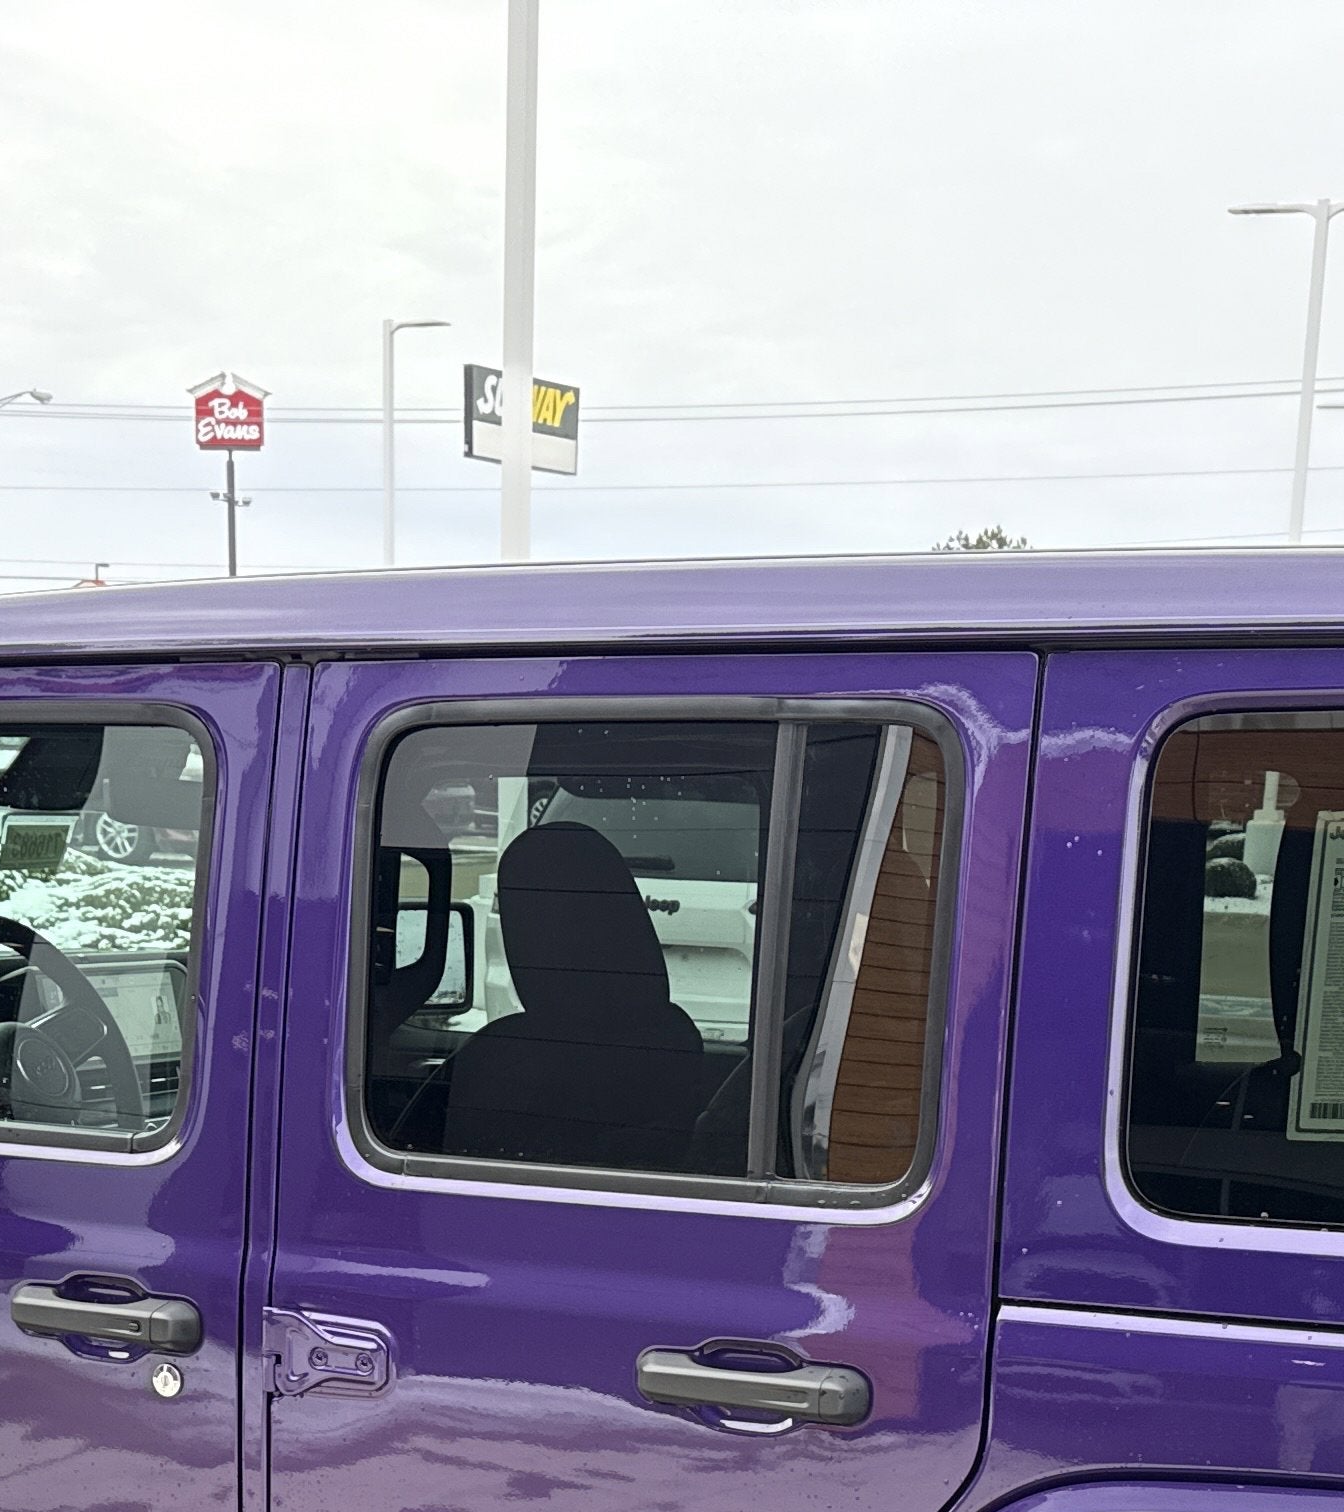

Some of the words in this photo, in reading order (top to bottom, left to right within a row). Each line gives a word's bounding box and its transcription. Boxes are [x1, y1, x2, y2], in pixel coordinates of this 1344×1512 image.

[208, 397, 249, 421] Bob
[476, 374, 576, 428] SWAY
[197, 416, 261, 443] Evans
